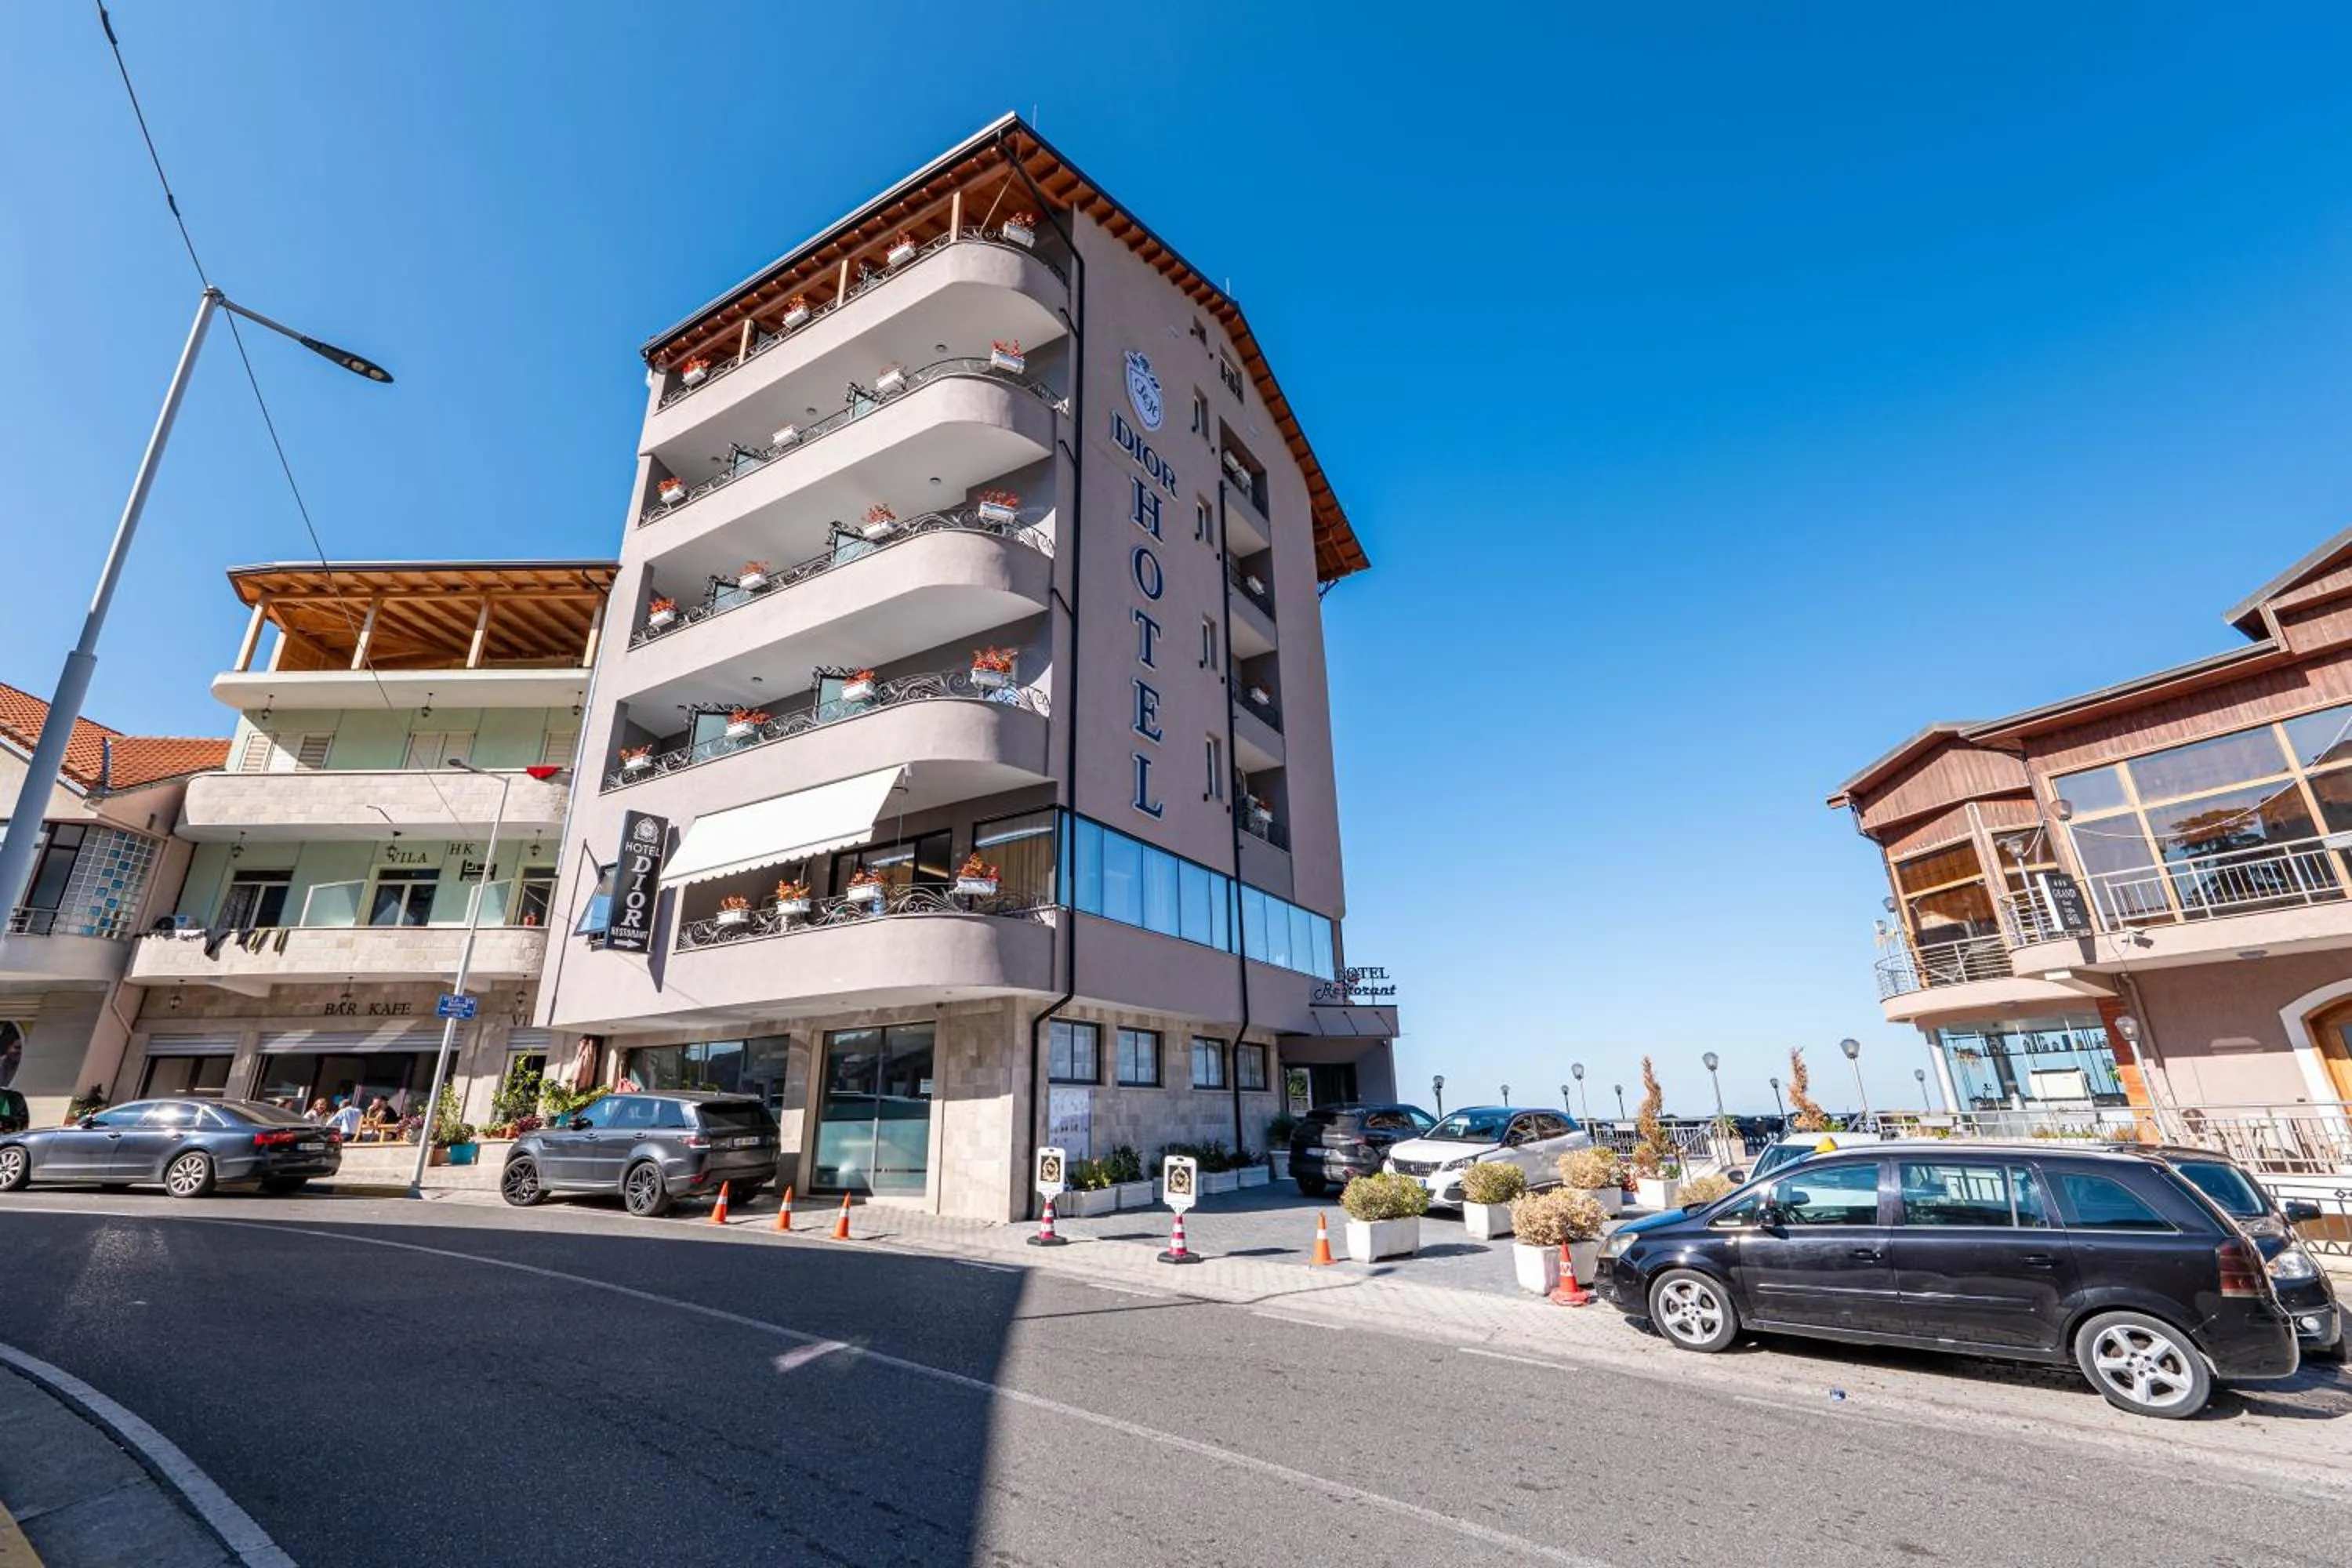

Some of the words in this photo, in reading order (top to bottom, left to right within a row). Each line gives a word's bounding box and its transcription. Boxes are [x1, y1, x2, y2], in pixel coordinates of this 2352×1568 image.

[1112, 411, 1178, 500] DIOR
[1131, 475, 1164, 819] HOTEL
[388, 851, 427, 863] VILA
[448, 843, 476, 855] HK
[625, 841, 660, 857] HOTEL
[620, 855, 652, 927] DIOR
[324, 1003, 357, 1016] BAR
[368, 1003, 412, 1016] KAFE
